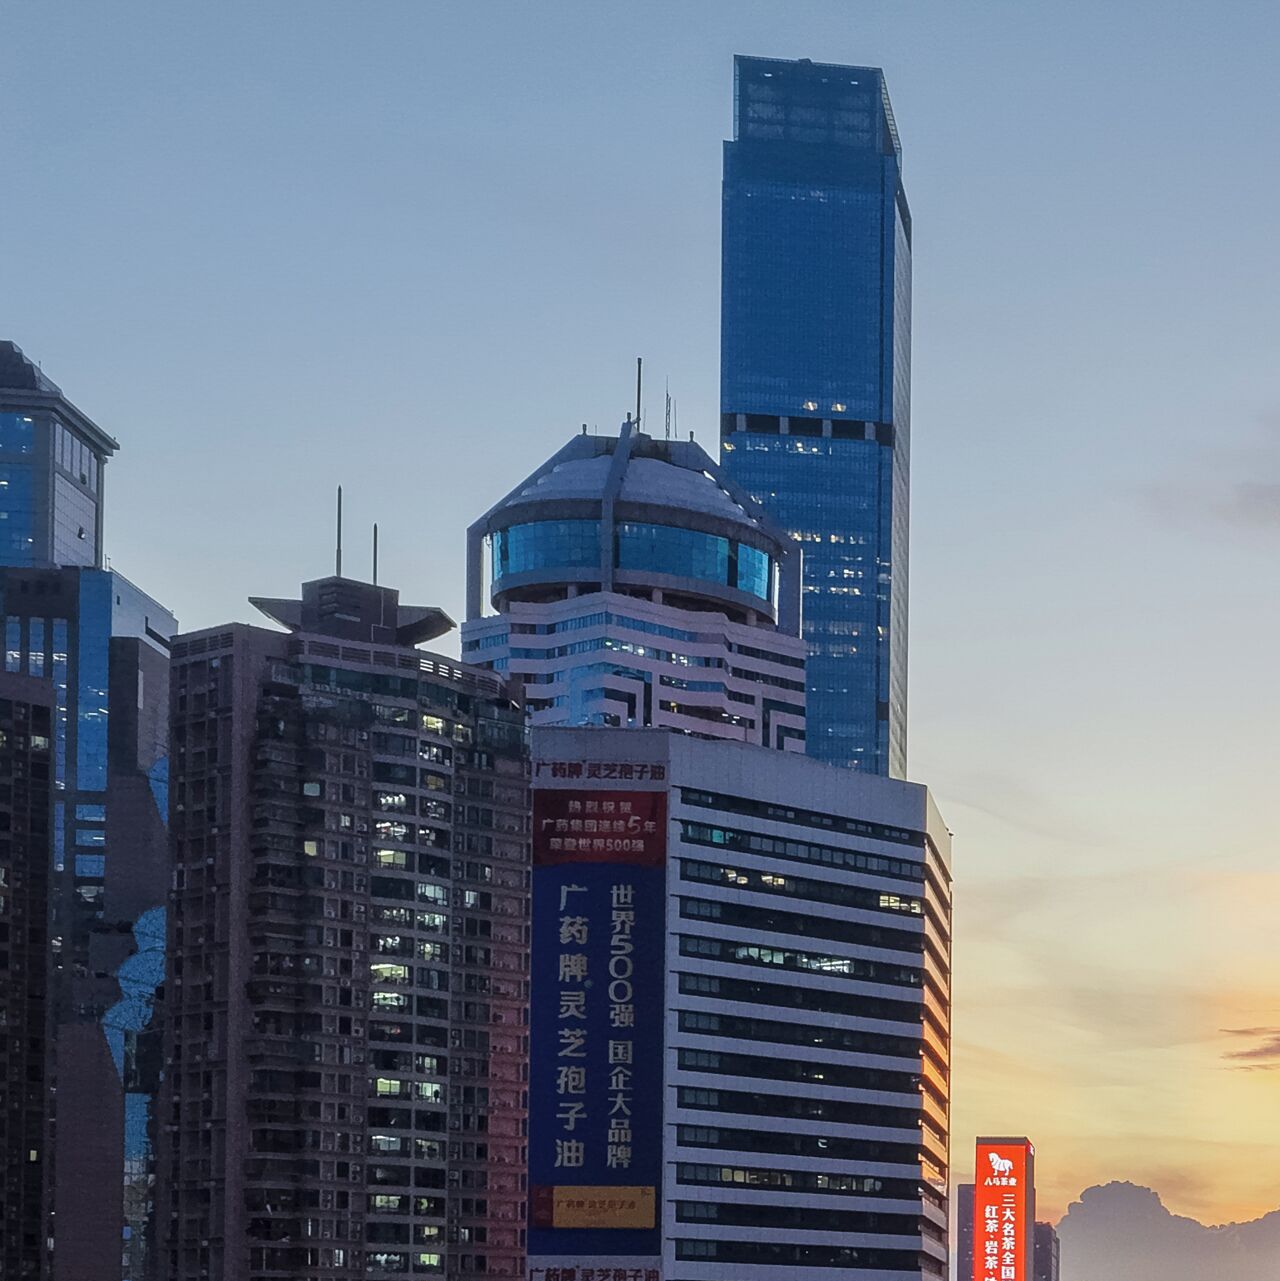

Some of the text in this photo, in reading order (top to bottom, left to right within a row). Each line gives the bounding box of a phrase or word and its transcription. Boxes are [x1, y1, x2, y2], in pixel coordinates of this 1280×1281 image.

[607, 884, 635, 1168] 世界500强 国企大品牌
[984, 1177, 1017, 1186] 八马茶业
